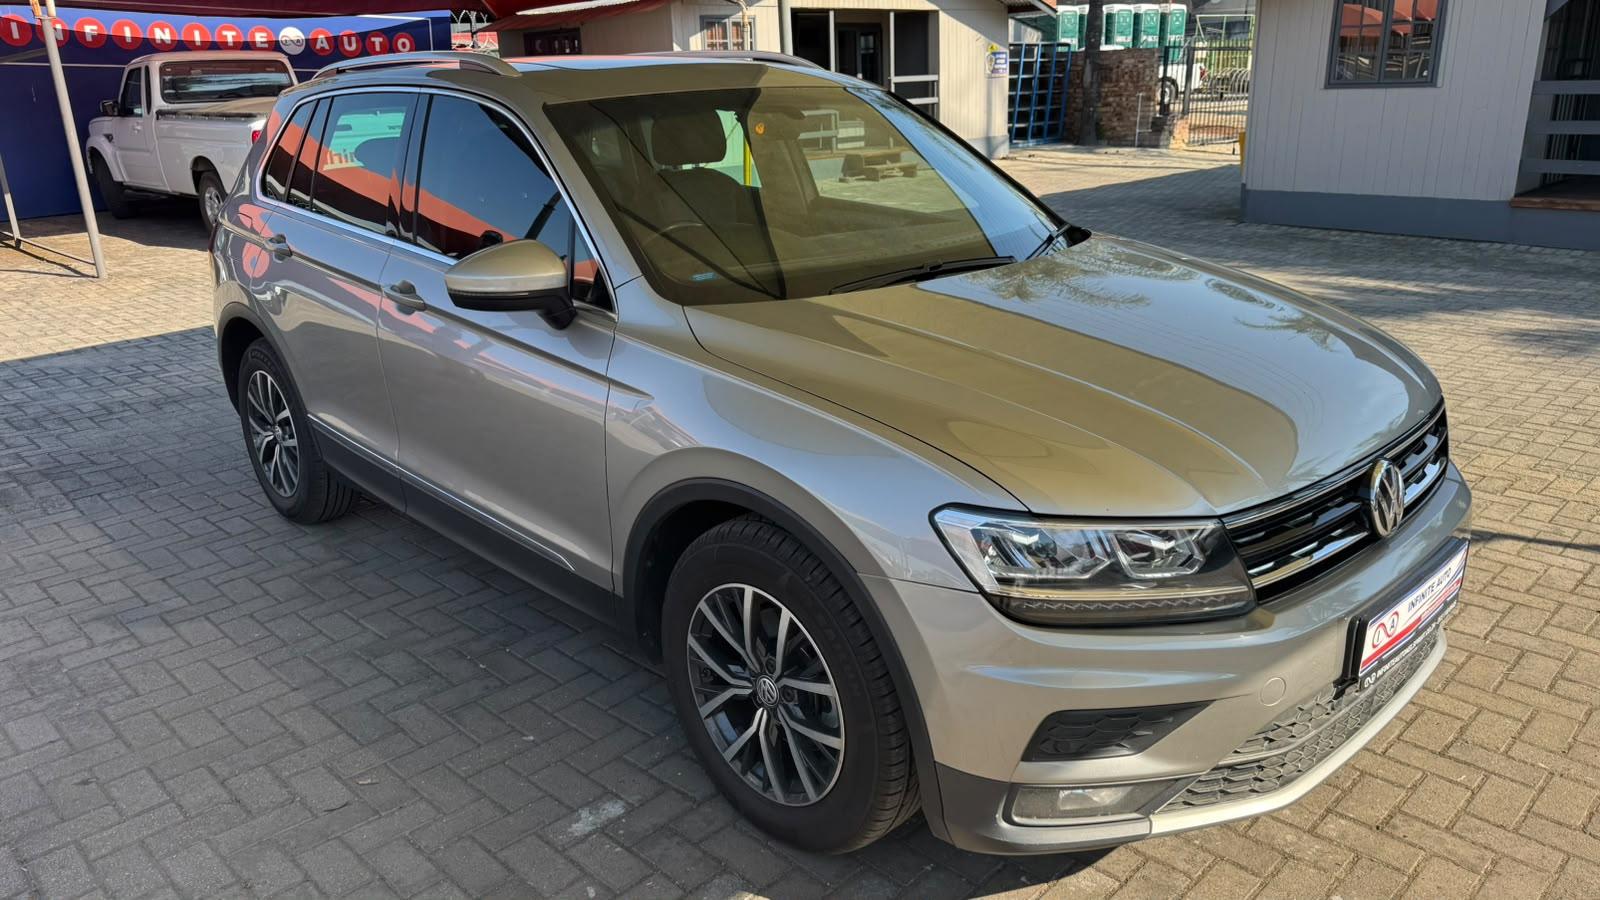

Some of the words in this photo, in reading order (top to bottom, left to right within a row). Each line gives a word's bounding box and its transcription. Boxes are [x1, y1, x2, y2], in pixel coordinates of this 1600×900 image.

[315, 35, 411, 53] AUTO
[1407, 581, 1436, 612] INFINITE
[1436, 566, 1452, 587] AUTO
